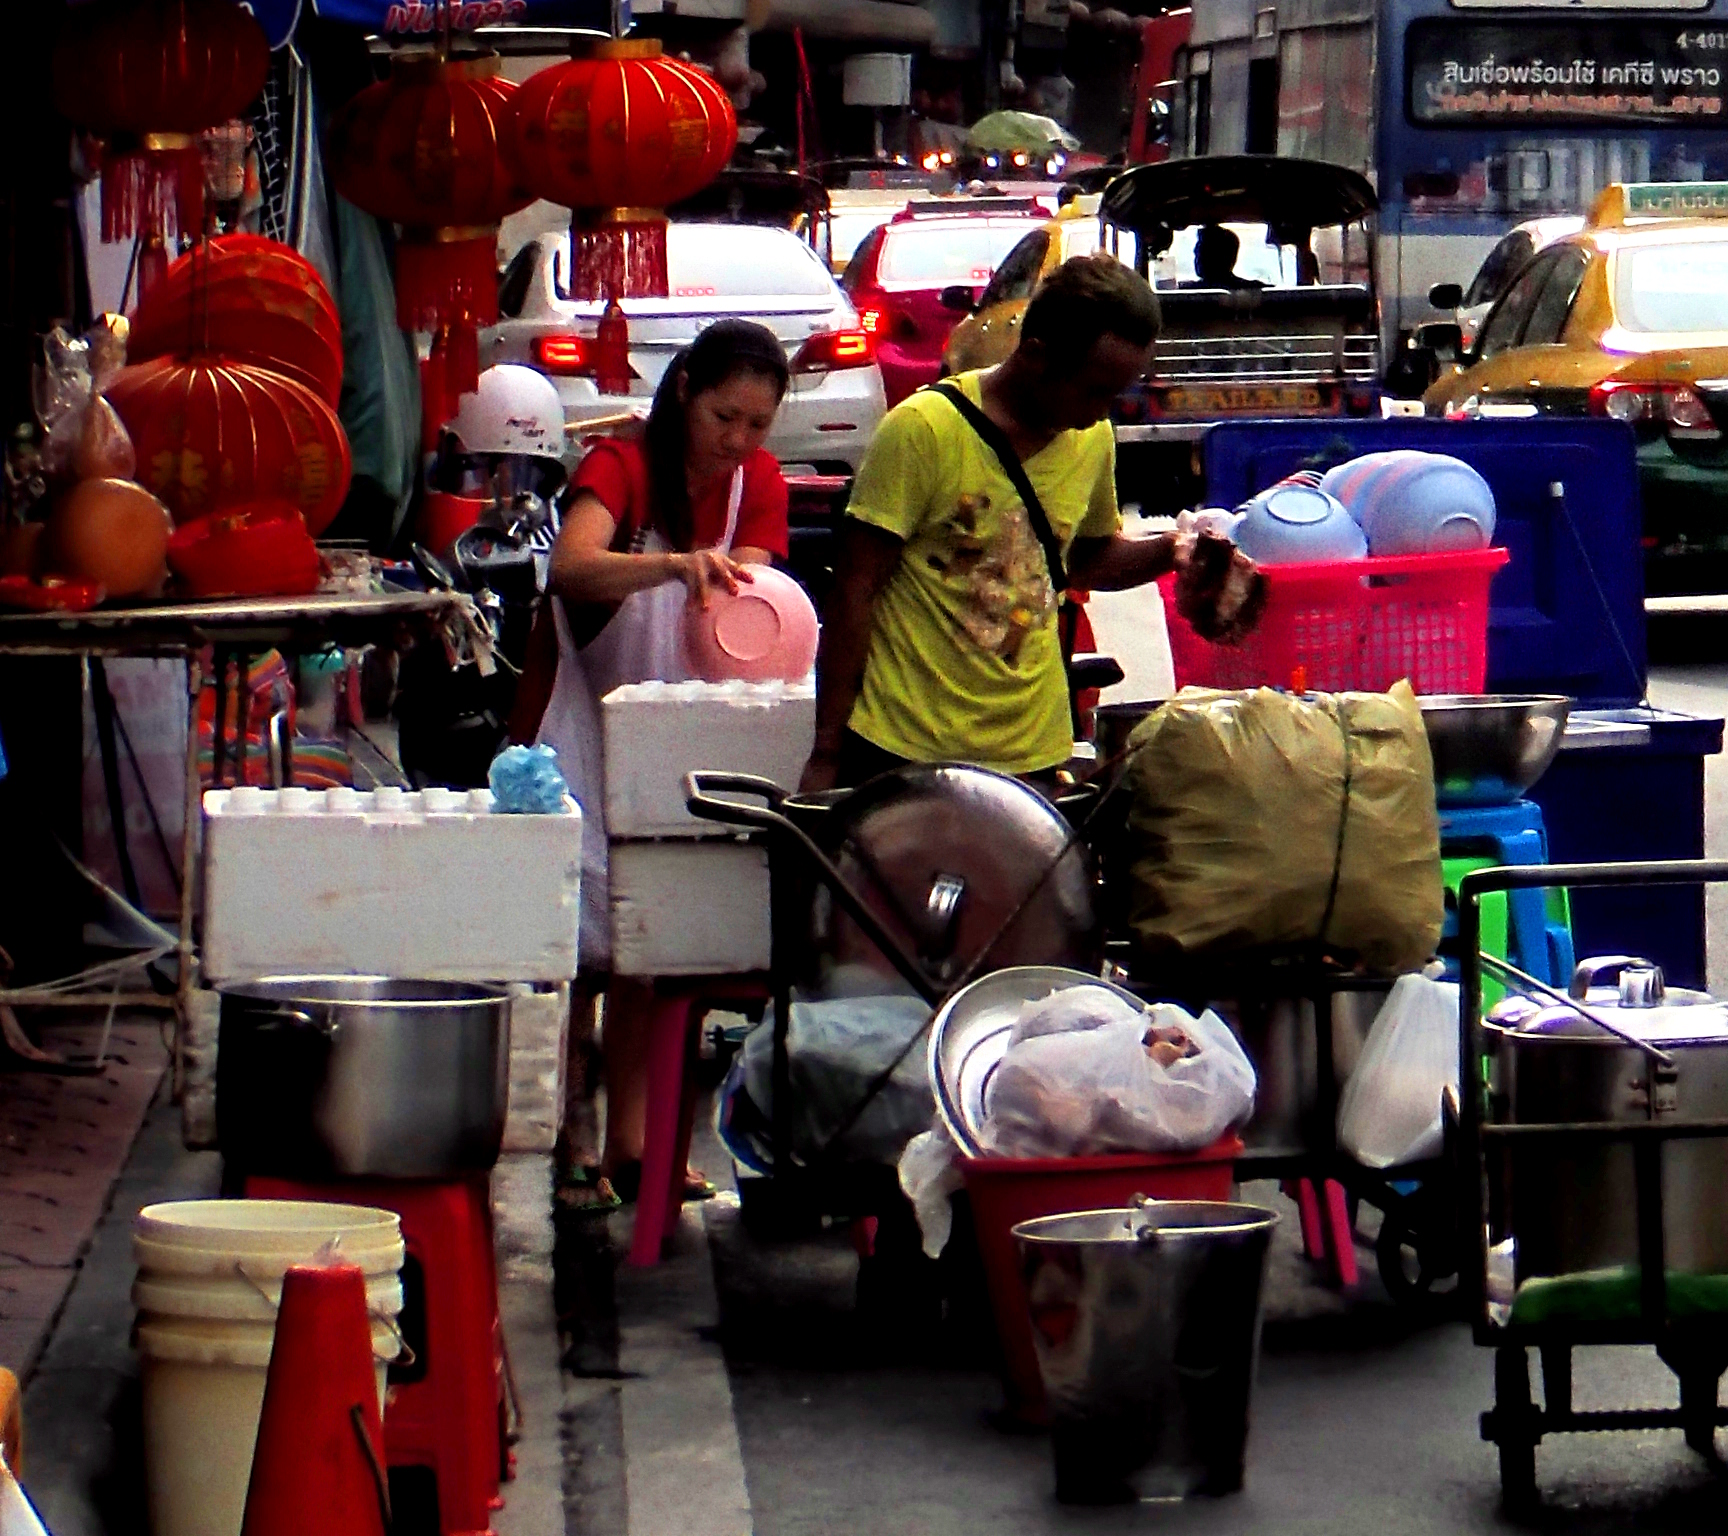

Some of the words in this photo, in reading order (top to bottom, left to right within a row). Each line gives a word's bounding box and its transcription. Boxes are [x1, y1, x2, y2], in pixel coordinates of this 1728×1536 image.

[1442, 53, 1596, 87] สินเชื่อพร้อมใช้
[1661, 67, 1720, 88] พราว
